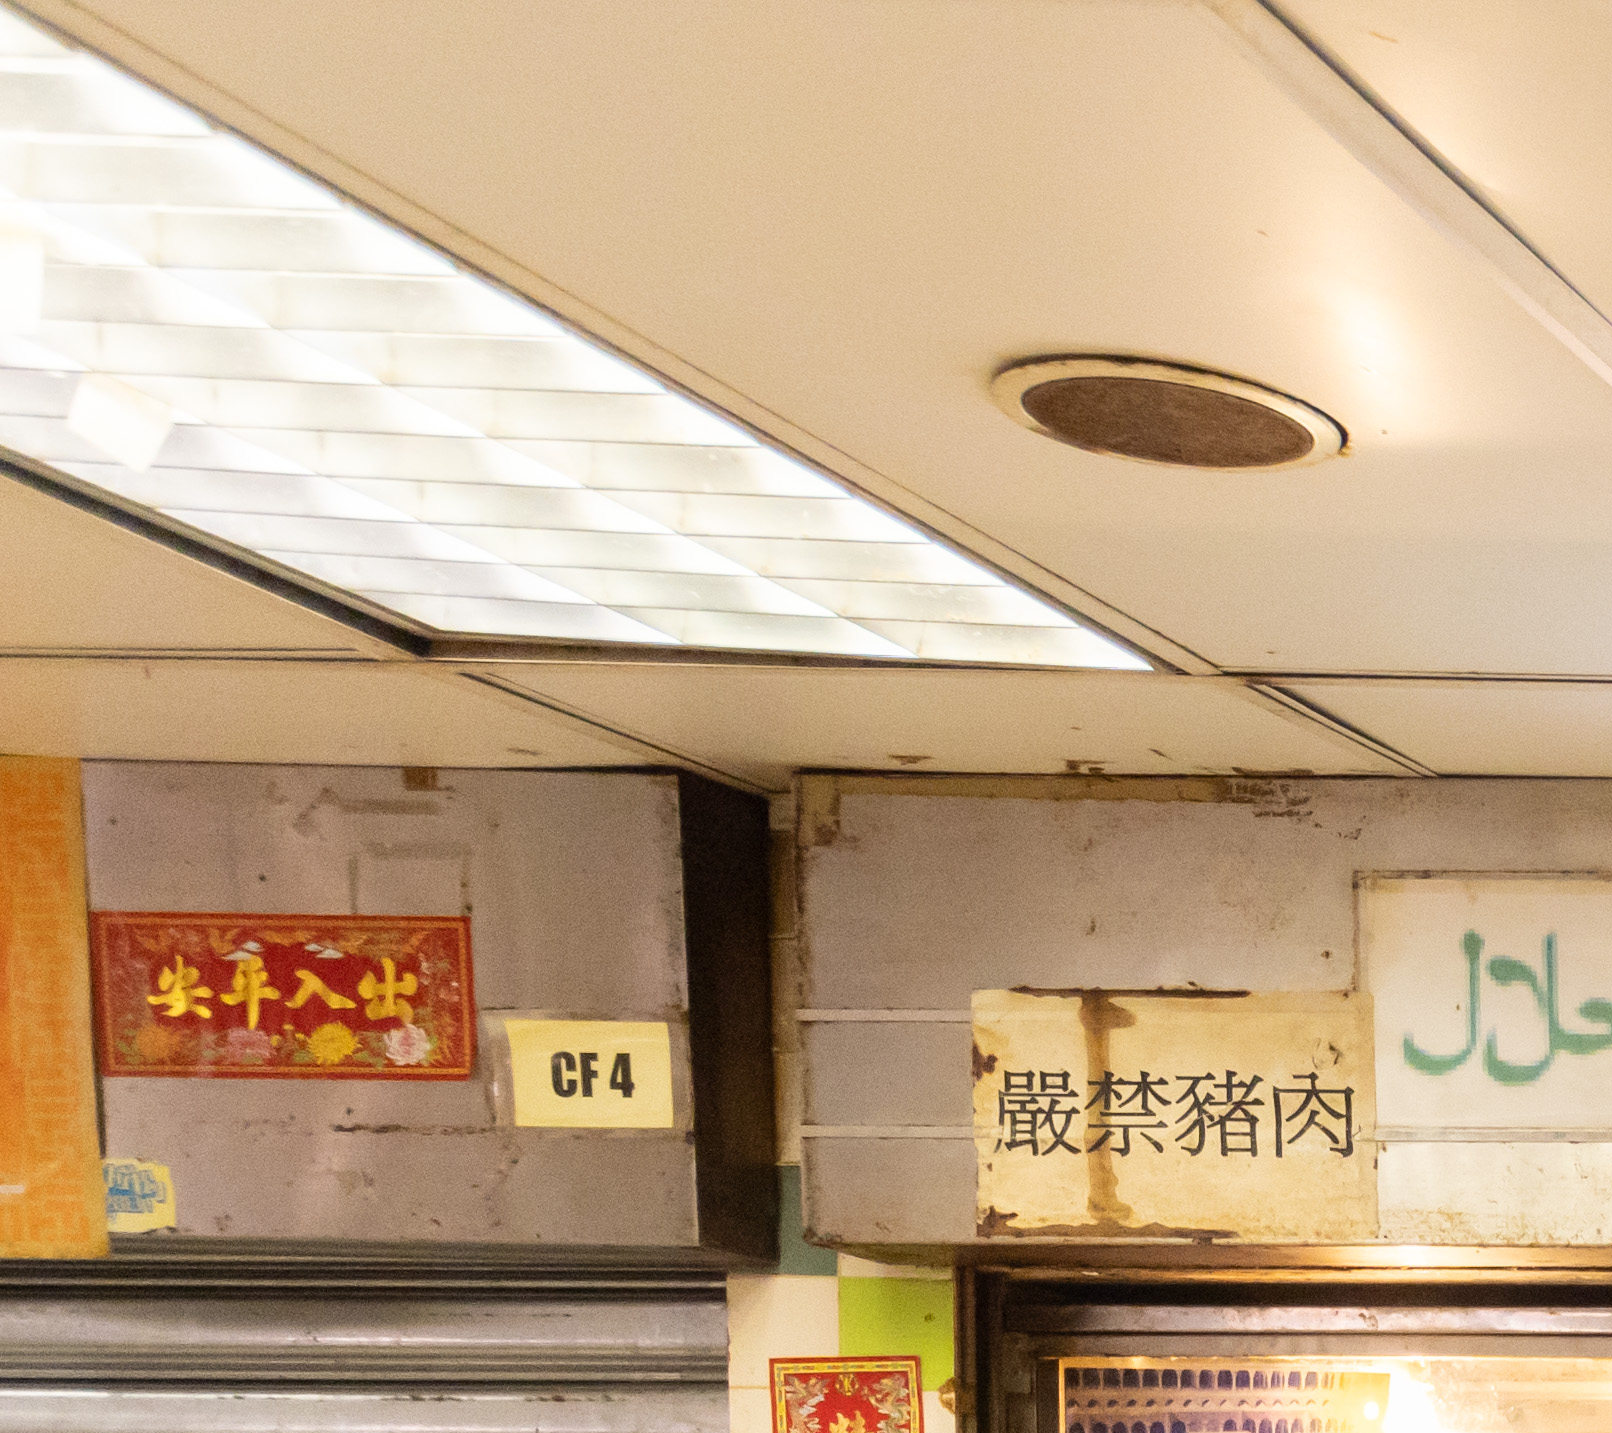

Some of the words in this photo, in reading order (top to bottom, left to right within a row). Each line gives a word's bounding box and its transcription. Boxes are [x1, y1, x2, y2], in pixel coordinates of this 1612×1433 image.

[551, 1051, 598, 1099] CF
[609, 1052, 635, 1098] 4
[996, 1070, 1356, 1158] 嚴禁豬肉
